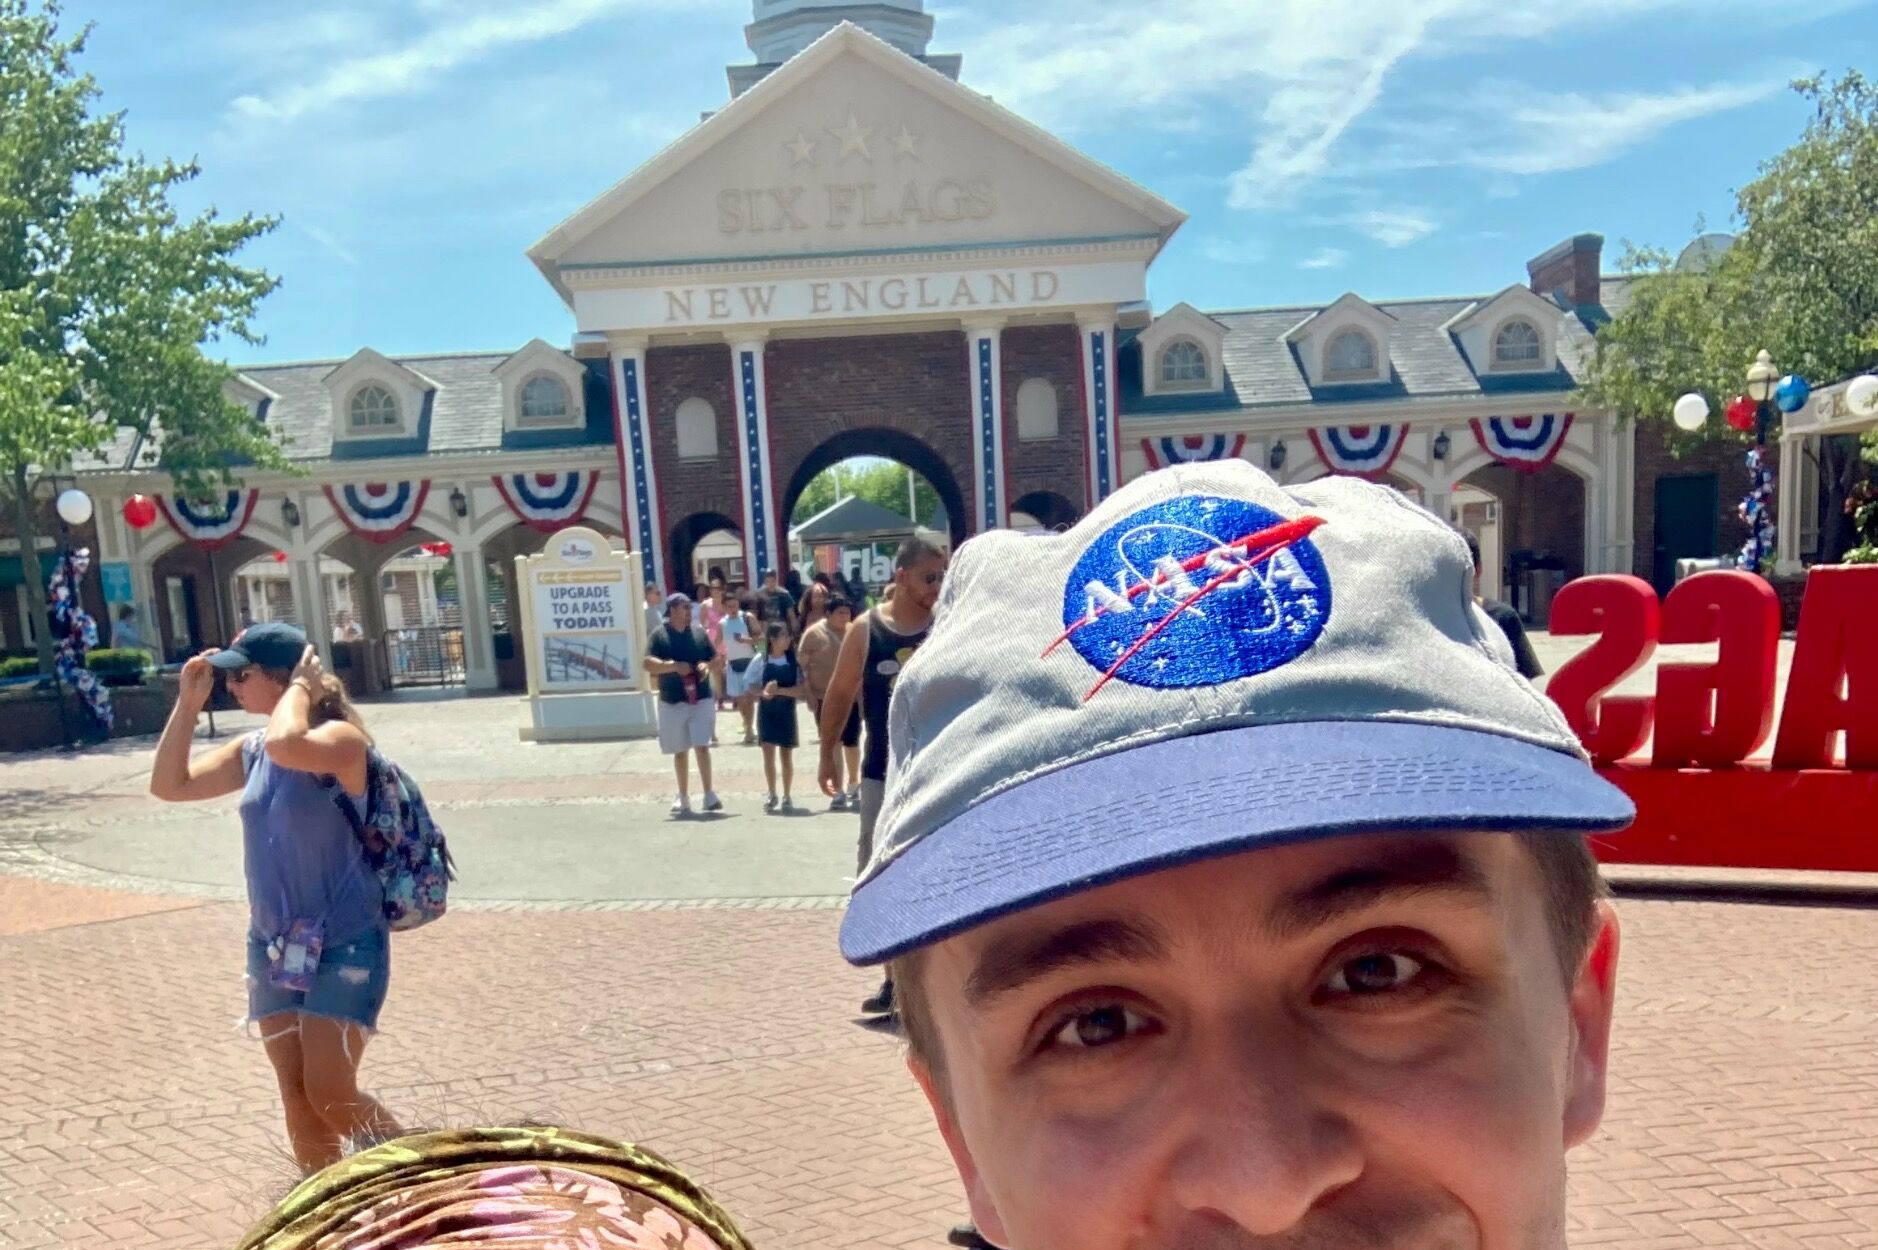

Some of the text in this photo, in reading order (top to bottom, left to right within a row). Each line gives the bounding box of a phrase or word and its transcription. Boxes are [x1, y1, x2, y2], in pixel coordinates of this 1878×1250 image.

[716, 175, 997, 234] SIX FLAGS
[664, 270, 1061, 321] NEW ENGLAND
[842, 547, 898, 583] Fla
[550, 585, 611, 599] UPGRADE
[1083, 545, 1319, 624] NASA
[552, 601, 613, 615] TO A PASS
[553, 616, 615, 629] TODAY!
